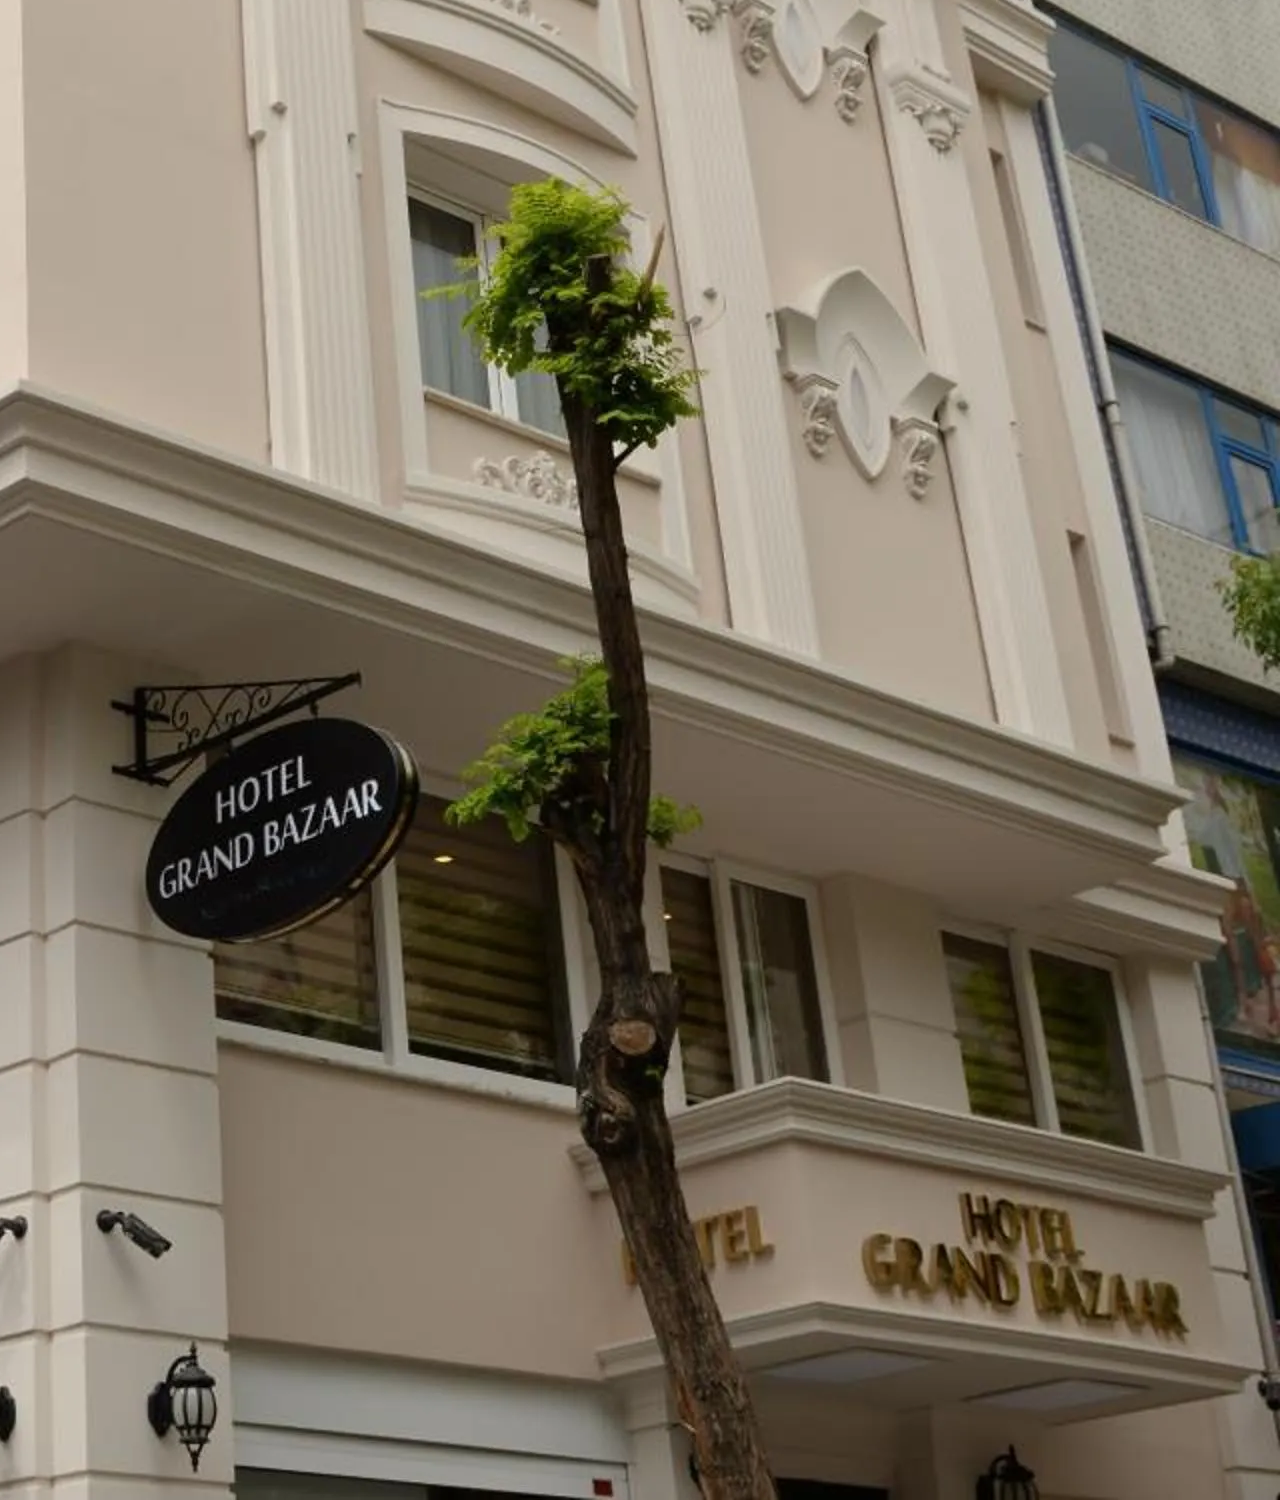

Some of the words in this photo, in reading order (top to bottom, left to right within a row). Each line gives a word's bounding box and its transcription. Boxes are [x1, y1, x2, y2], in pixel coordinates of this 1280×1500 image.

[216, 755, 312, 823] HOTEL
[159, 832, 255, 900] GRAND
[263, 779, 383, 857] BAZAAR
[622, 1205, 775, 1288] TEL
[959, 1192, 1086, 1265] HOTEL
[862, 1232, 1020, 1311] GRAND
[1028, 1260, 1189, 1343] BAZAAR
